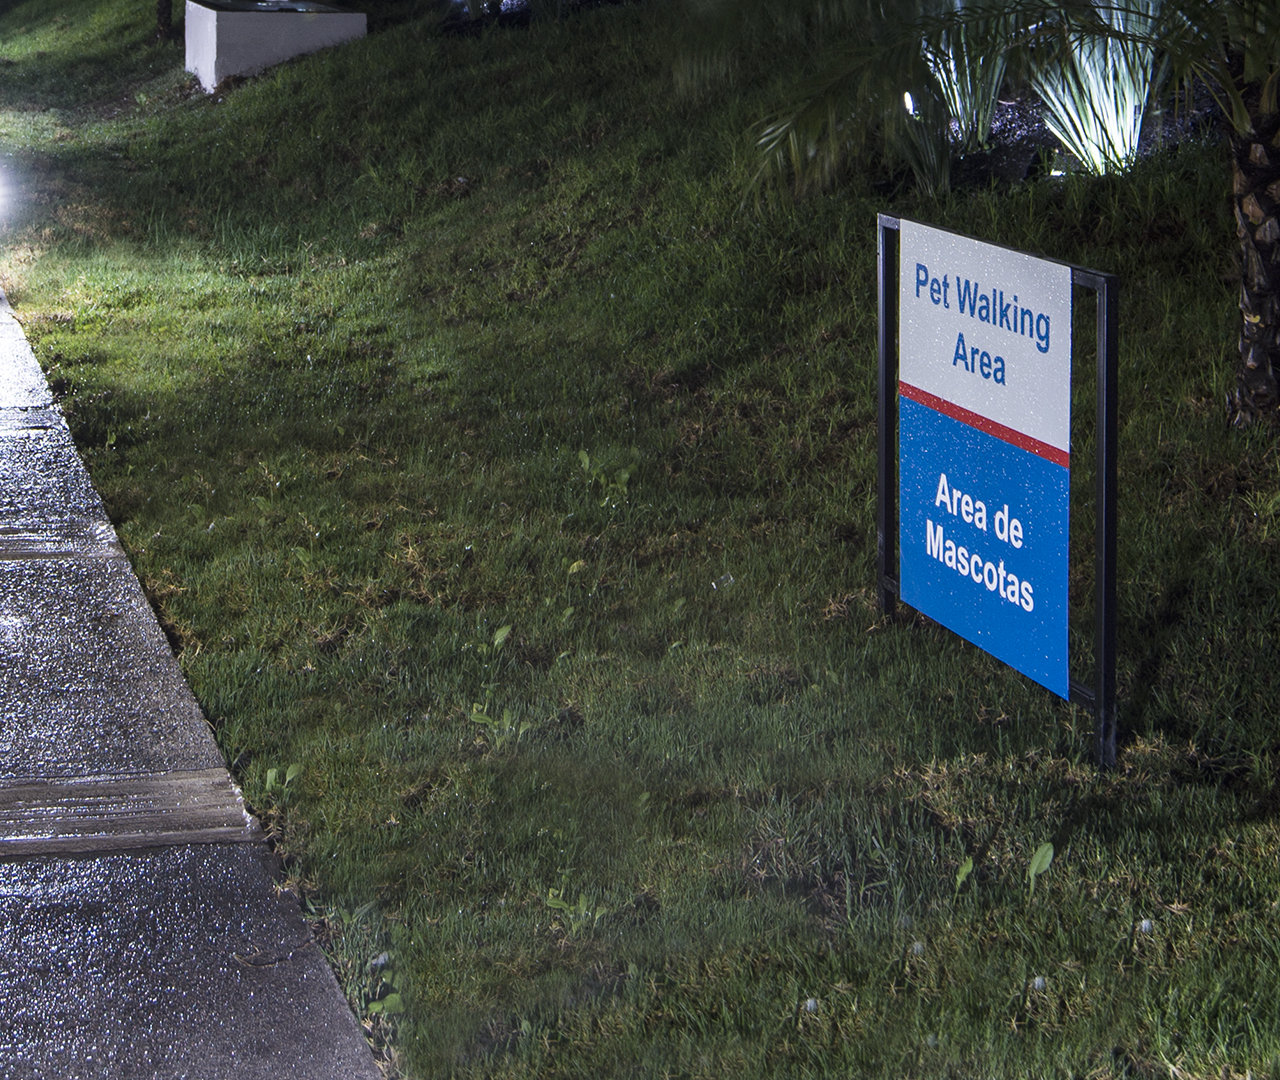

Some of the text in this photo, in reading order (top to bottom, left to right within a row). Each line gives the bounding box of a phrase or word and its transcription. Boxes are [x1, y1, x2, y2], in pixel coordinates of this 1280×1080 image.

[915, 262, 1051, 354] Pet Walking
[952, 332, 1007, 386] Area
[935, 472, 1023, 549] Area de
[926, 519, 1035, 613] Mascotas
